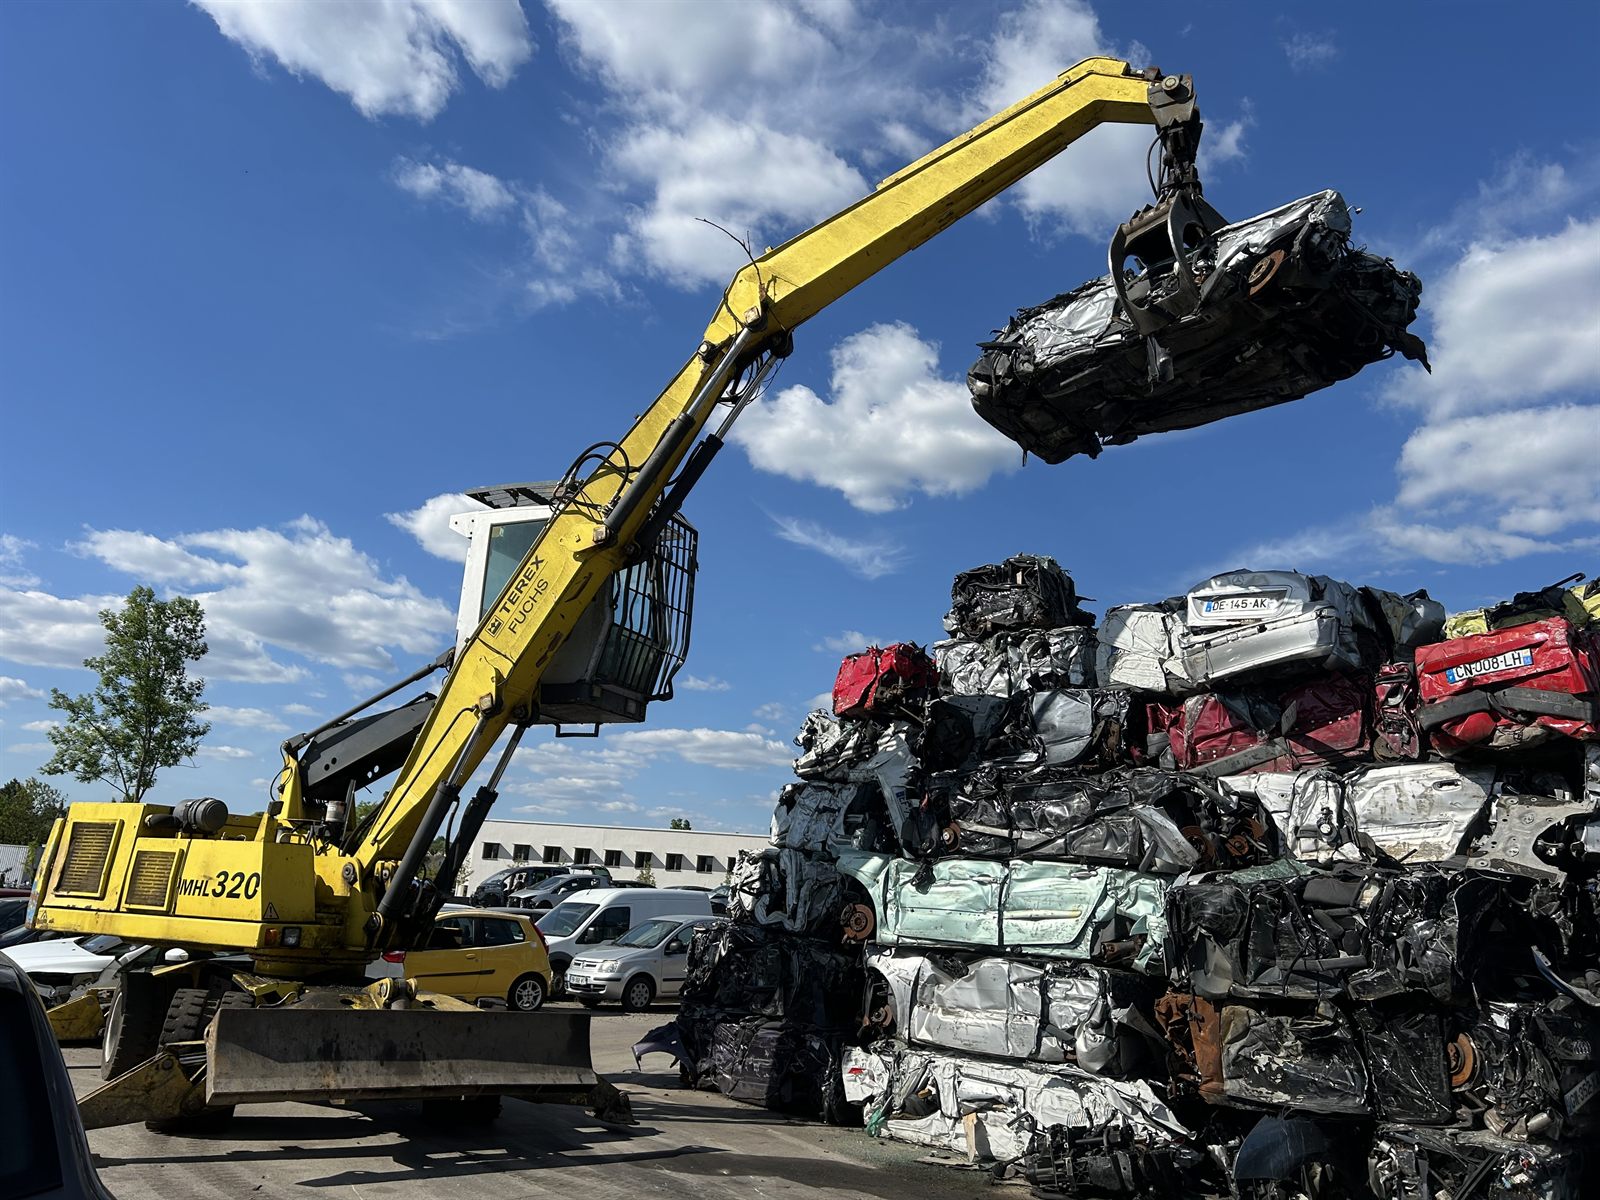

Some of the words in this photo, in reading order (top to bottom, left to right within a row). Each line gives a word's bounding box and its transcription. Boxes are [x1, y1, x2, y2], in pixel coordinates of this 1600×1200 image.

[499, 555, 545, 614] TEREX
[508, 578, 549, 634] FUCHS
[179, 878, 210, 897] MHL
[211, 871, 261, 899] 320
